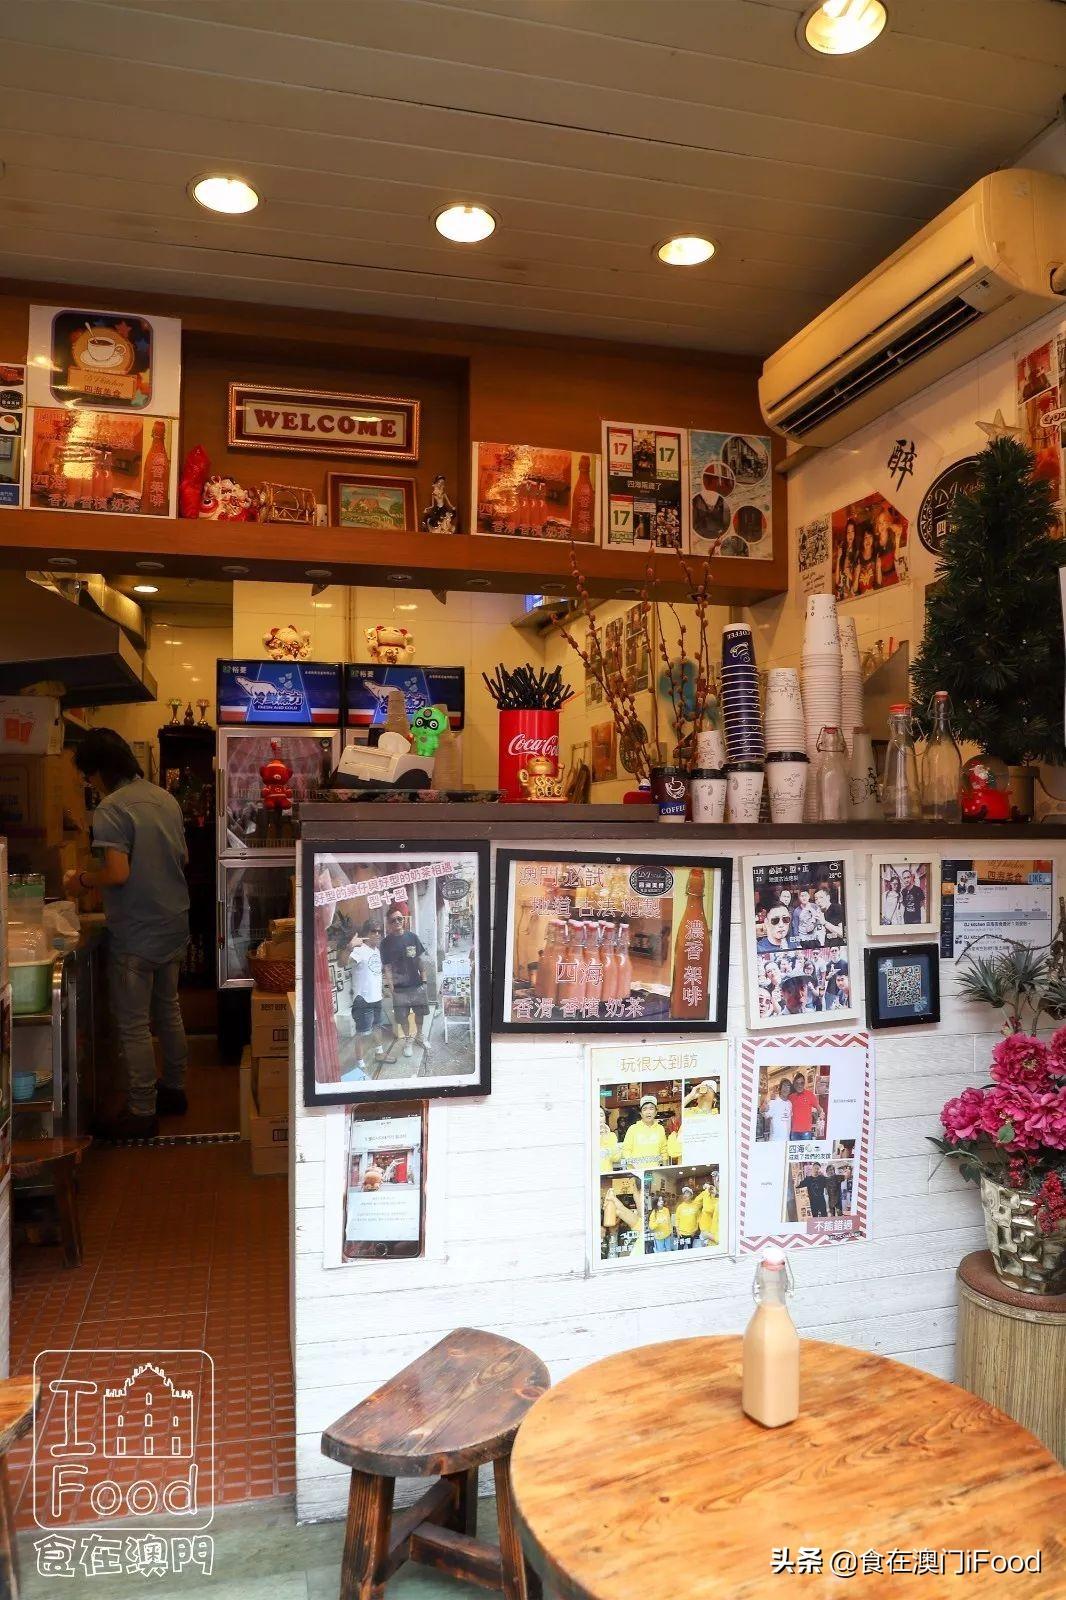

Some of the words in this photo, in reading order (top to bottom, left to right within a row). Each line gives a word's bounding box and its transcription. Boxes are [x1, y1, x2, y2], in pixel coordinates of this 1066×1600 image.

[254, 409, 397, 438] WELCOME
[613, 442, 628, 456] 17
[659, 447, 675, 462] 17
[613, 510, 631, 526] 17
[579, 897, 616, 918] 古法
[556, 961, 604, 985] 四海
[604, 997, 645, 1018] 奶茶
[620, 1052, 698, 1072] 玩很大到訪
[813, 1220, 853, 1231] 不能錯過
